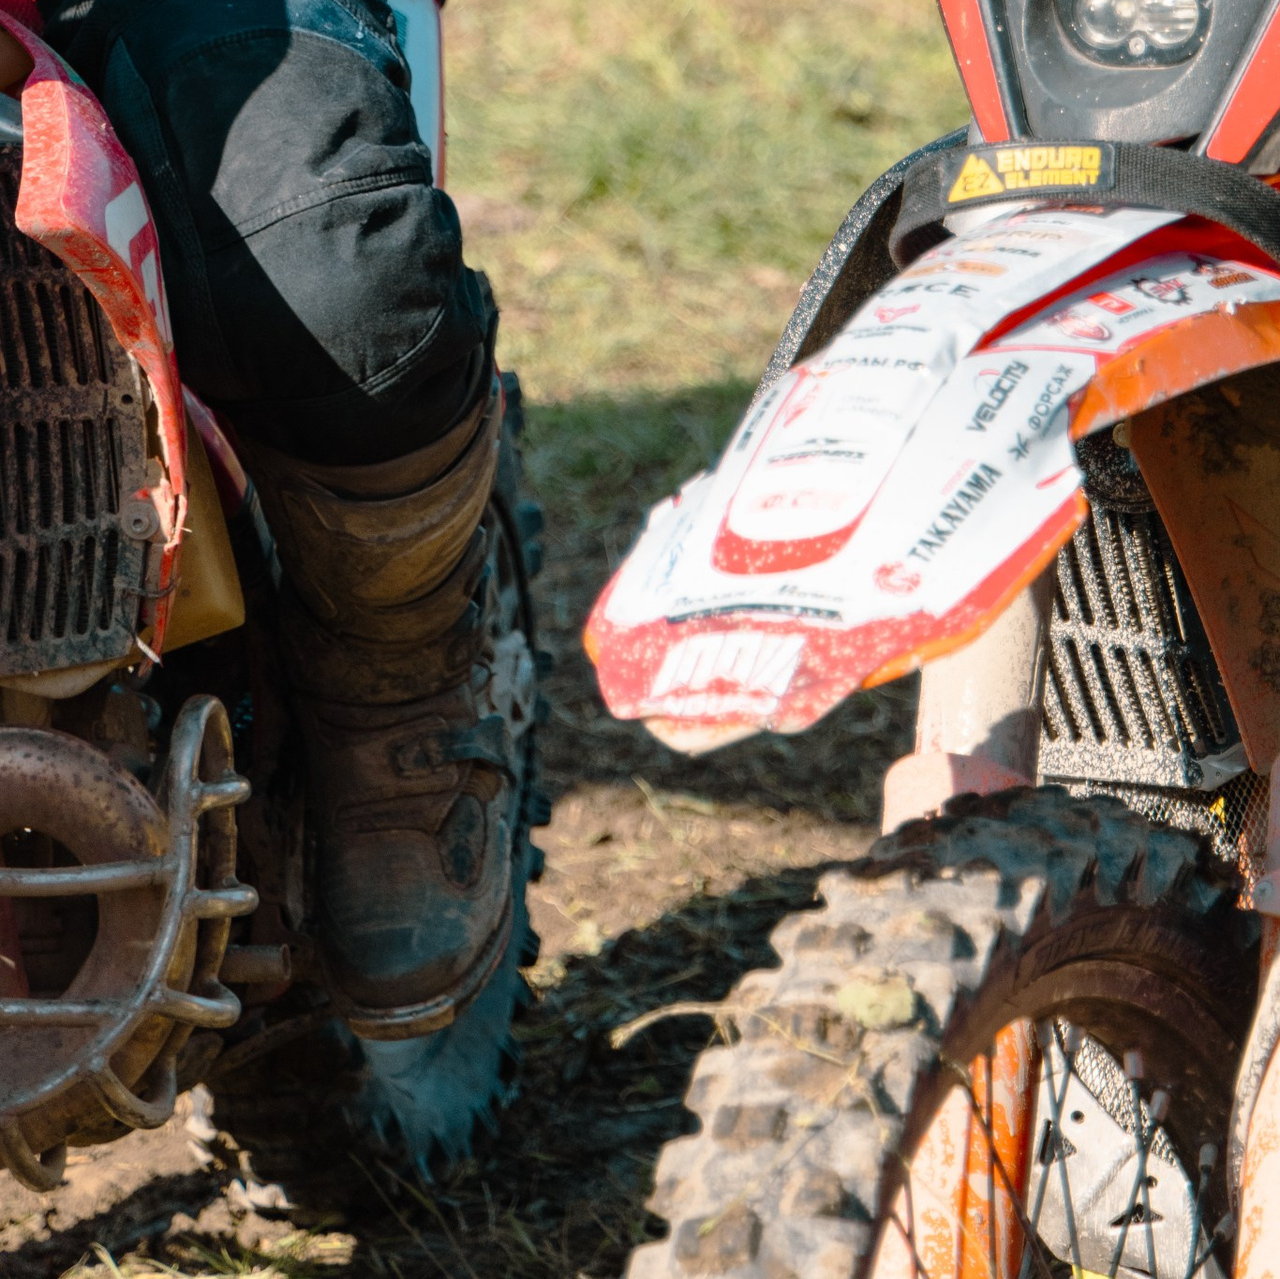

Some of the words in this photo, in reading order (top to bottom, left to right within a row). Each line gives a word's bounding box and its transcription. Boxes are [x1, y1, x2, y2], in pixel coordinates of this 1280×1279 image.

[996, 146, 1102, 173] ENDURO
[1004, 168, 1099, 190] ELEMENT
[966, 360, 1029, 432] VELOCITY
[1028, 364, 1074, 431] ФОРСАЖ
[907, 462, 1003, 563] TAKAYAMA
